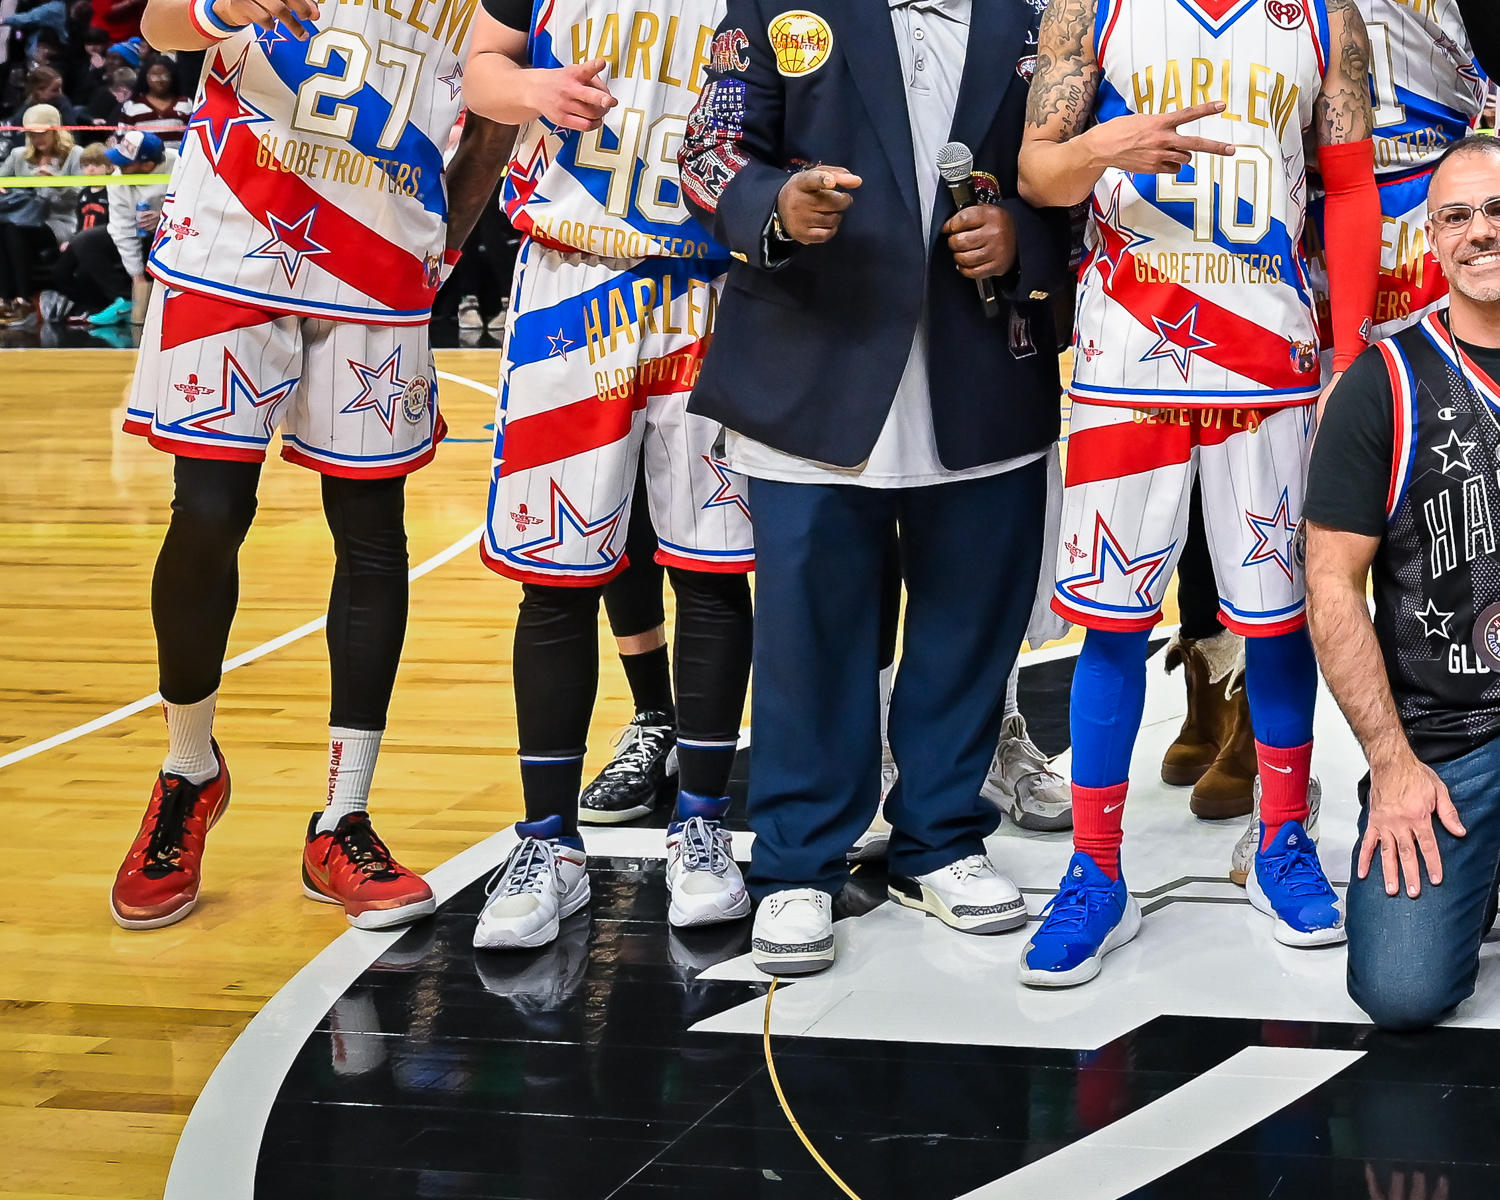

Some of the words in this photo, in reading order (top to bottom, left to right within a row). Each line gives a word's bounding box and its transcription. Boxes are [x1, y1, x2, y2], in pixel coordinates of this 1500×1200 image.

[571, 11, 717, 95] HARLE
[771, 31, 828, 47] HARLEM
[290, 26, 427, 150] 27
[1131, 57, 1300, 145] HARLEM
[255, 132, 423, 199] GLOBETROTTERS
[1155, 143, 1273, 244] 40
[1133, 252, 1282, 285] GLOBETROTTERS
[330, 740, 344, 766] GAME
[325, 783, 337, 807] LOVE
